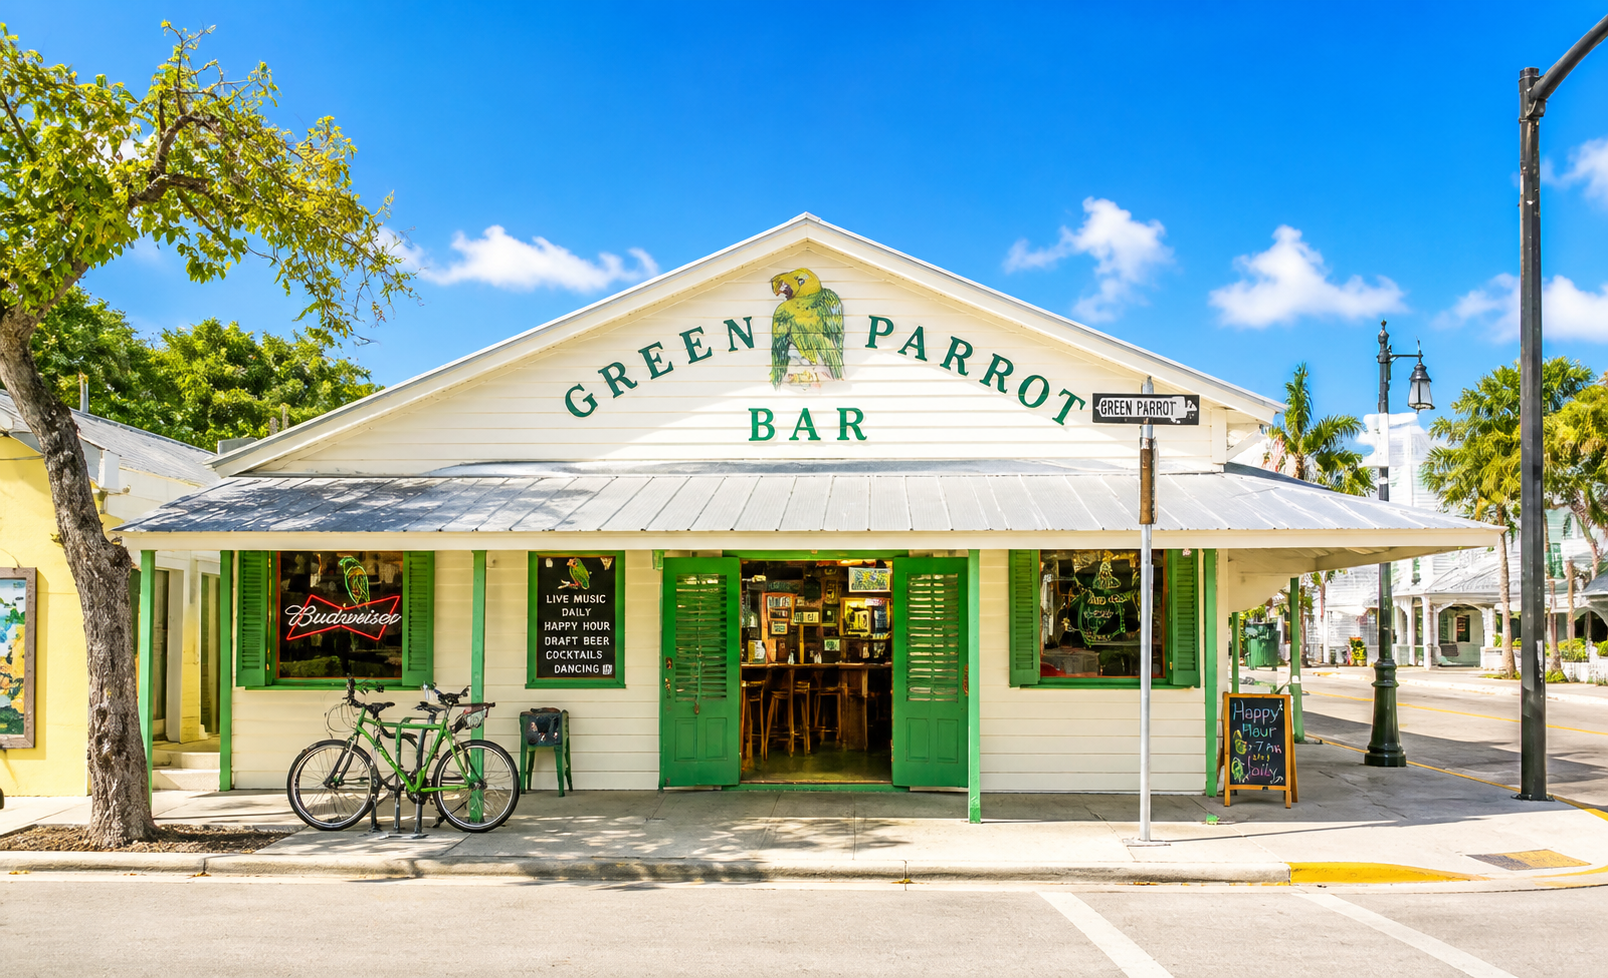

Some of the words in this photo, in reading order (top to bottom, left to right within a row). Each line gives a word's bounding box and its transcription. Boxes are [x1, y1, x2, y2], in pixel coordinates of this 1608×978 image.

[565, 316, 755, 418] GREEN
[865, 315, 1086, 427] PARROT
[1100, 399, 1133, 416] GREEN
[1137, 400, 1177, 416] PARROT
[748, 407, 867, 442] BAR
[546, 594, 569, 604] LIVE
[573, 594, 606, 604] MUSIC
[284, 604, 402, 628] Budweiser
[561, 607, 592, 617] DAILY
[544, 621, 578, 631] HAPPY
[583, 621, 611, 631] HOUR
[544, 636, 578, 646] DRAFT
[583, 636, 610, 646] BEER
[545, 650, 603, 660] COCKTAILS
[554, 664, 600, 674] DANCING
[1233, 700, 1279, 725] Happy
